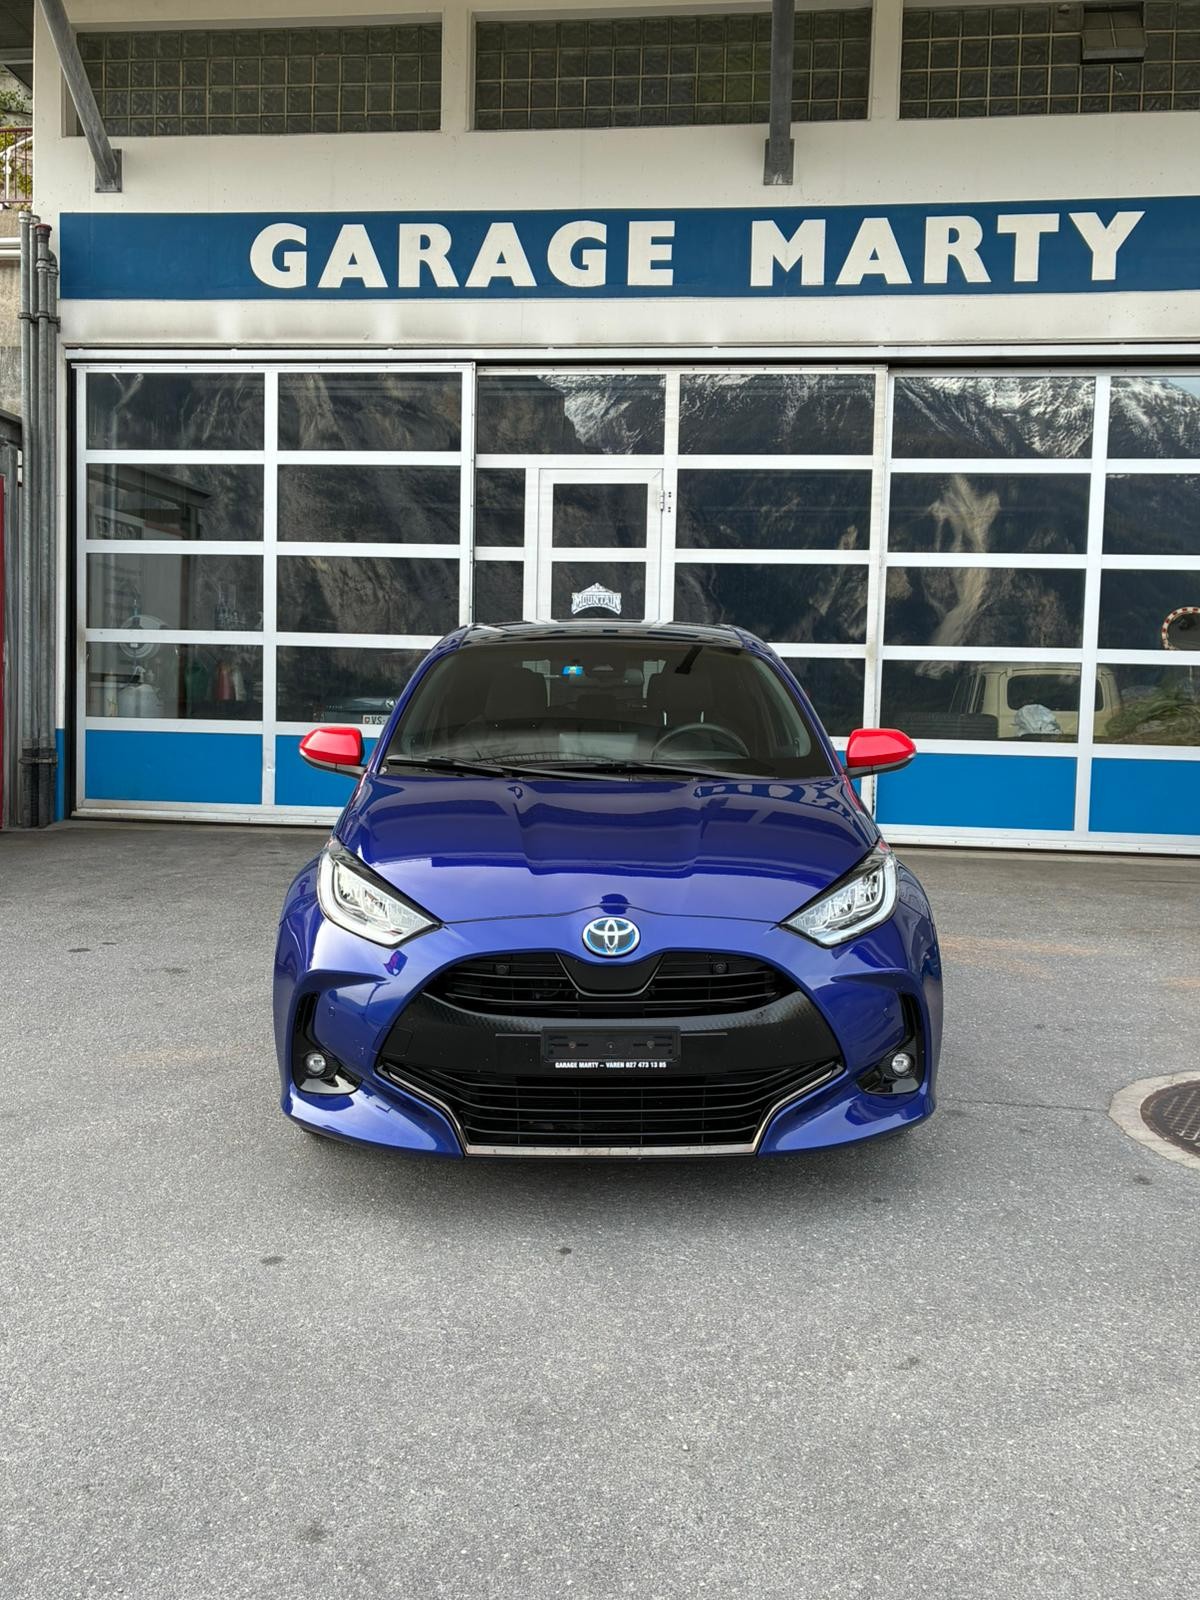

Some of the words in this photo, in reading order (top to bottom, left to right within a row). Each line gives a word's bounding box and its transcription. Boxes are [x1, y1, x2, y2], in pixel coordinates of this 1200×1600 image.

[249, 219, 675, 290] GARAGE
[749, 210, 1145, 287] MARTY
[571, 592, 621, 614] MOUNTAIN
